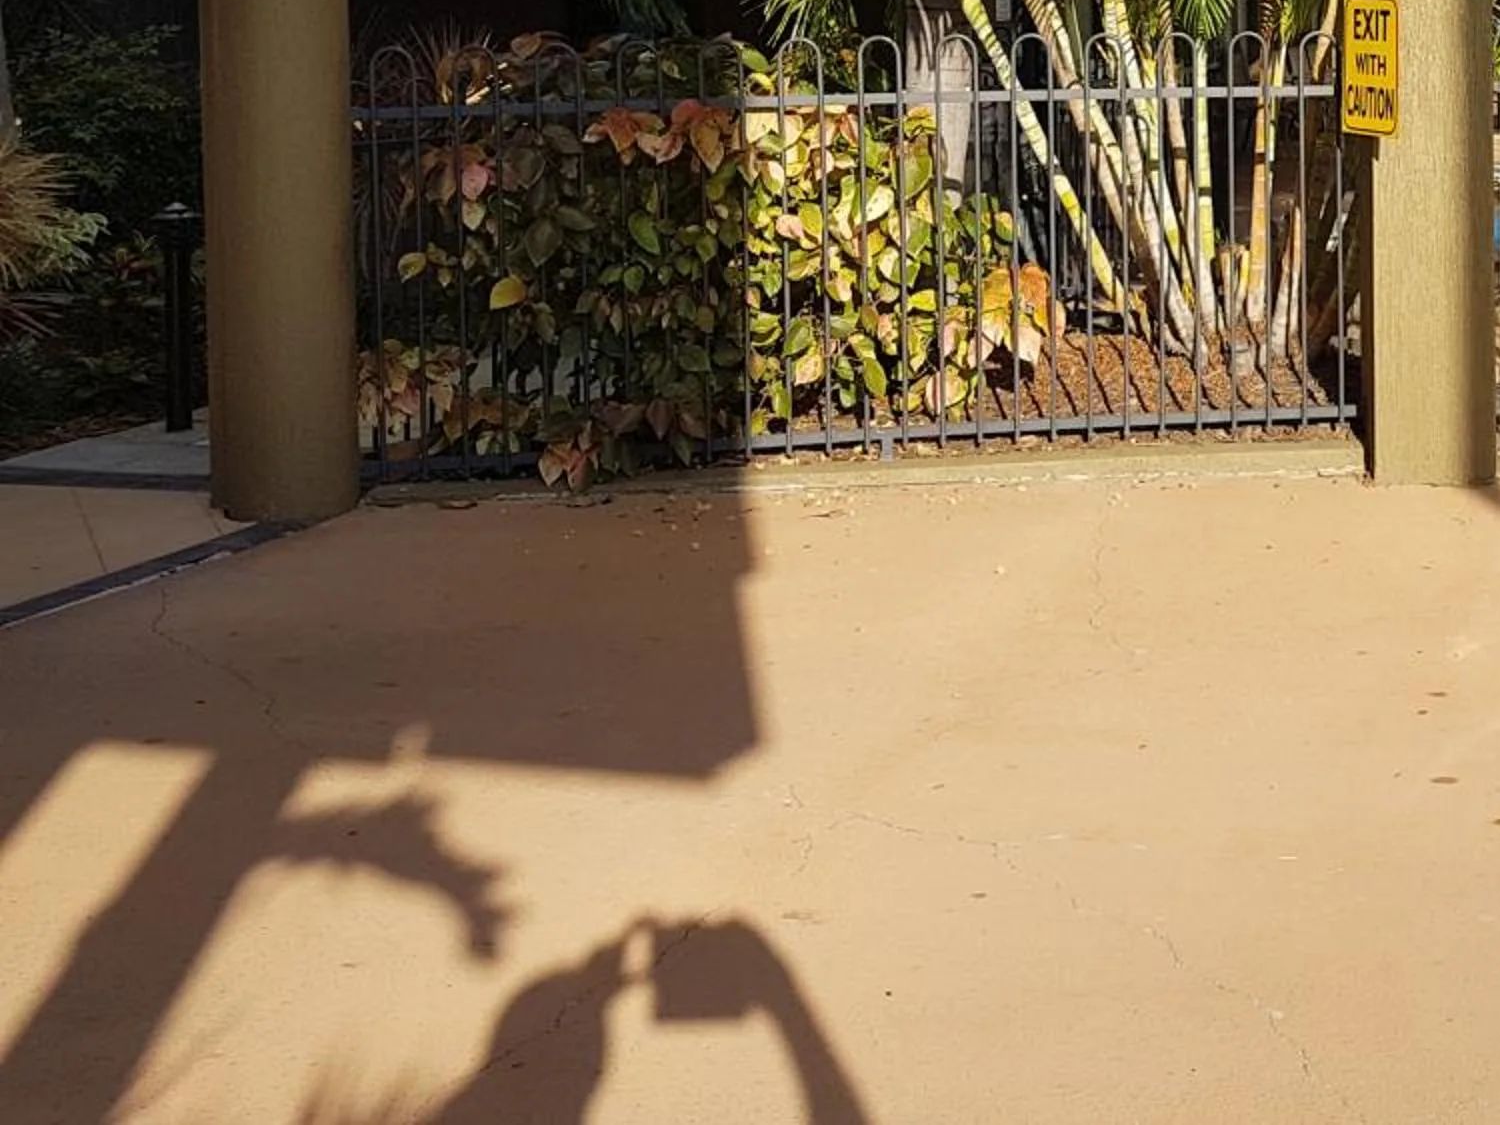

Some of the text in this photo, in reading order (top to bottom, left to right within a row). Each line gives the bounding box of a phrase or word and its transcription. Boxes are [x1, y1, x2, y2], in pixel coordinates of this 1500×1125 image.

[1353, 8, 1391, 42] EXIT
[1356, 52, 1387, 76] WITH
[1347, 84, 1394, 122] CAUTION
